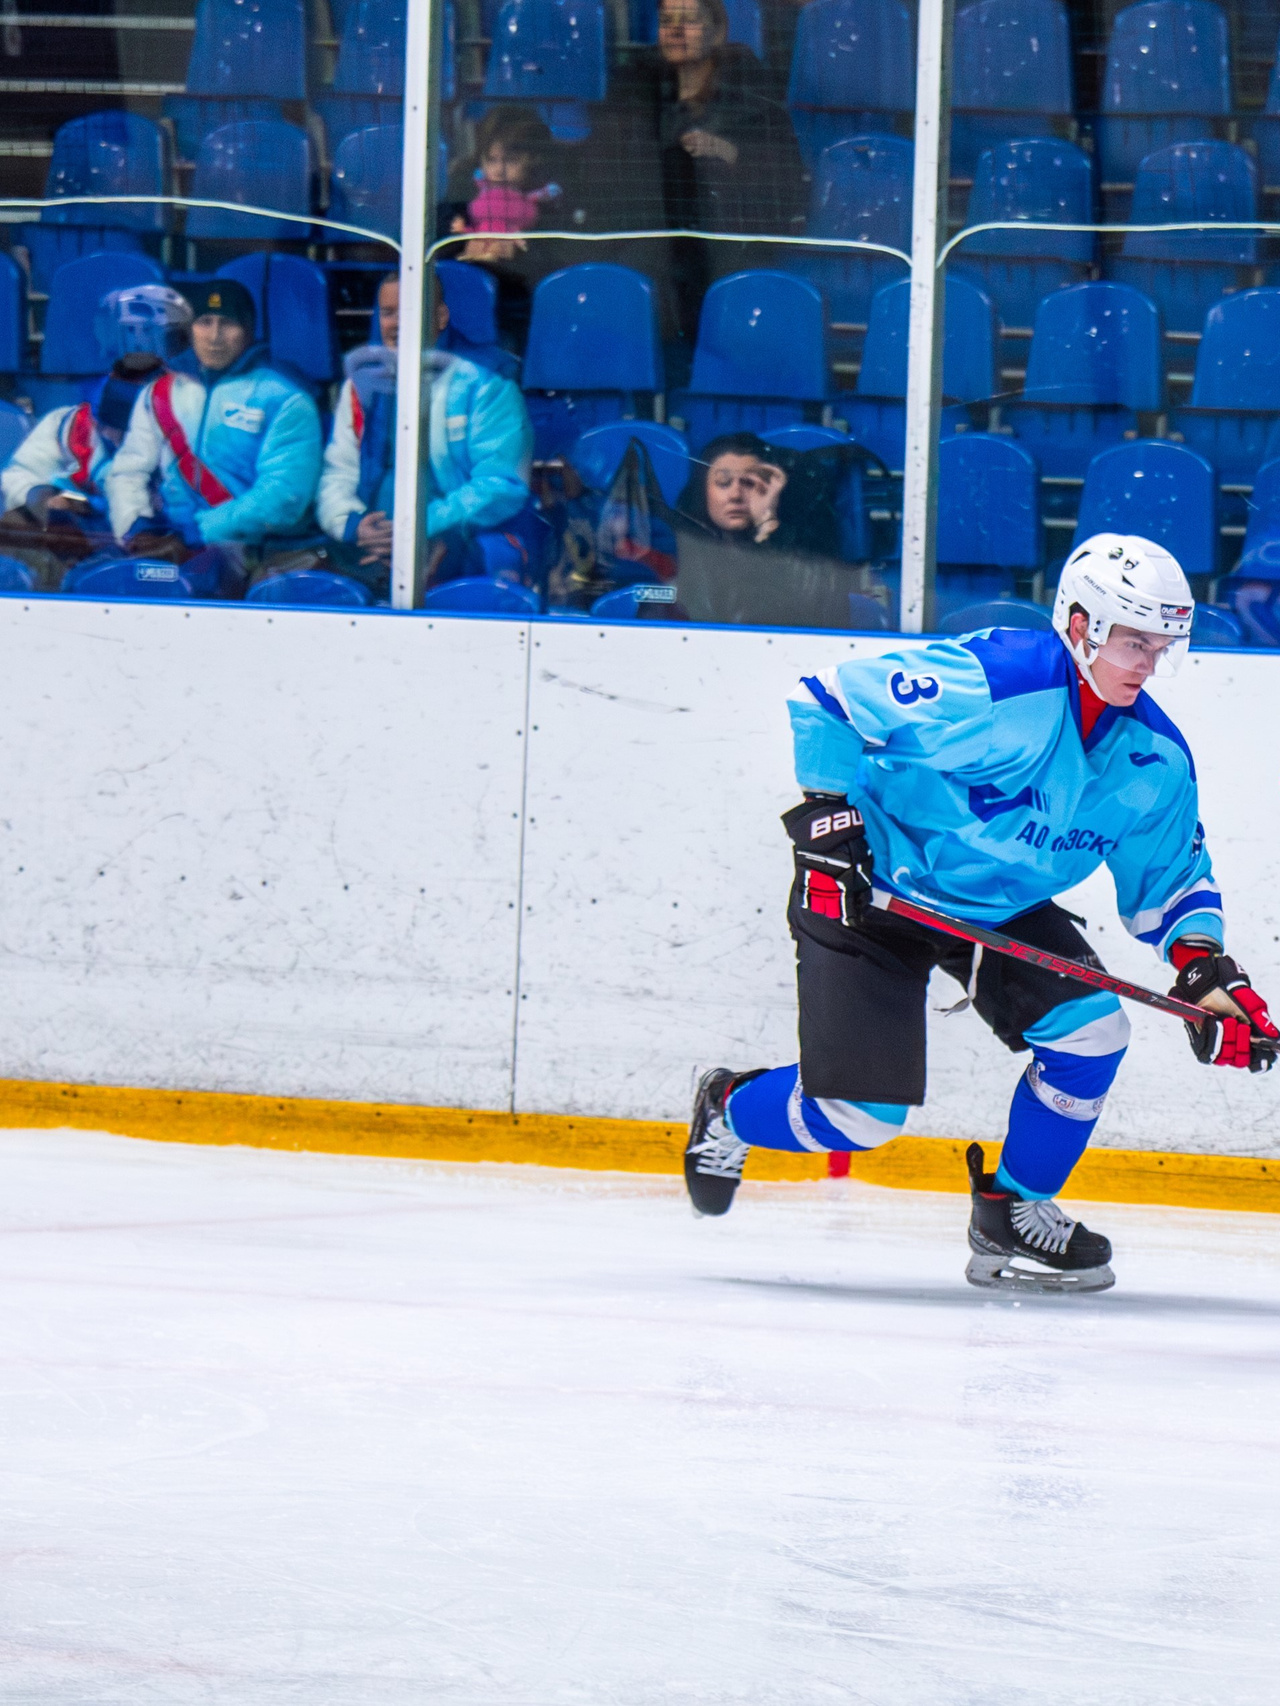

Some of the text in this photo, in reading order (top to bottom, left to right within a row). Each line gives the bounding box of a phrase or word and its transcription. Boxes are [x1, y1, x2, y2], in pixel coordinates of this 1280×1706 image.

[888, 669, 942, 708] 3
[810, 809, 864, 841] BAU
[998, 941, 1136, 997] JETSPEED
